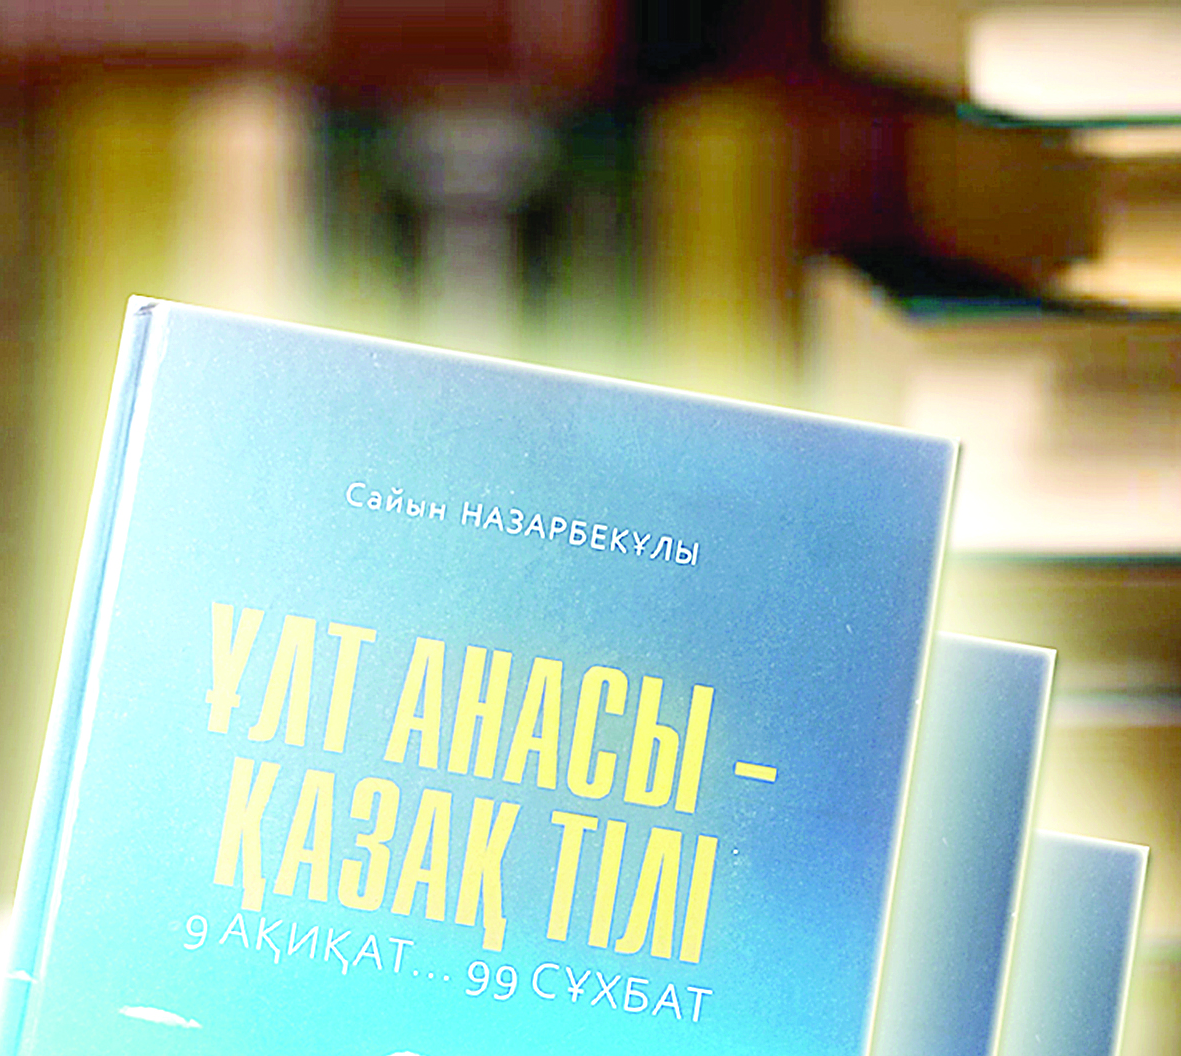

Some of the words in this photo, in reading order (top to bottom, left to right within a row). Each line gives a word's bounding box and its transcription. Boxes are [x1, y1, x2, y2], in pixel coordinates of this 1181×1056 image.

[345, 481, 447, 521] Сайын
[461, 501, 700, 566] НАЗАРБЕКҰЛЫ
[205, 601, 377, 753] ҰЛТ
[383, 636, 714, 814] АНАСЫ
[213, 756, 521, 953] ҚАЗАҚ
[546, 811, 719, 964] ТІЛІ
[182, 914, 209, 951] 9
[219, 913, 451, 983] АҚИҚАТ...
[466, 960, 518, 1001] 99
[530, 962, 713, 1023] СҰХБАТ
